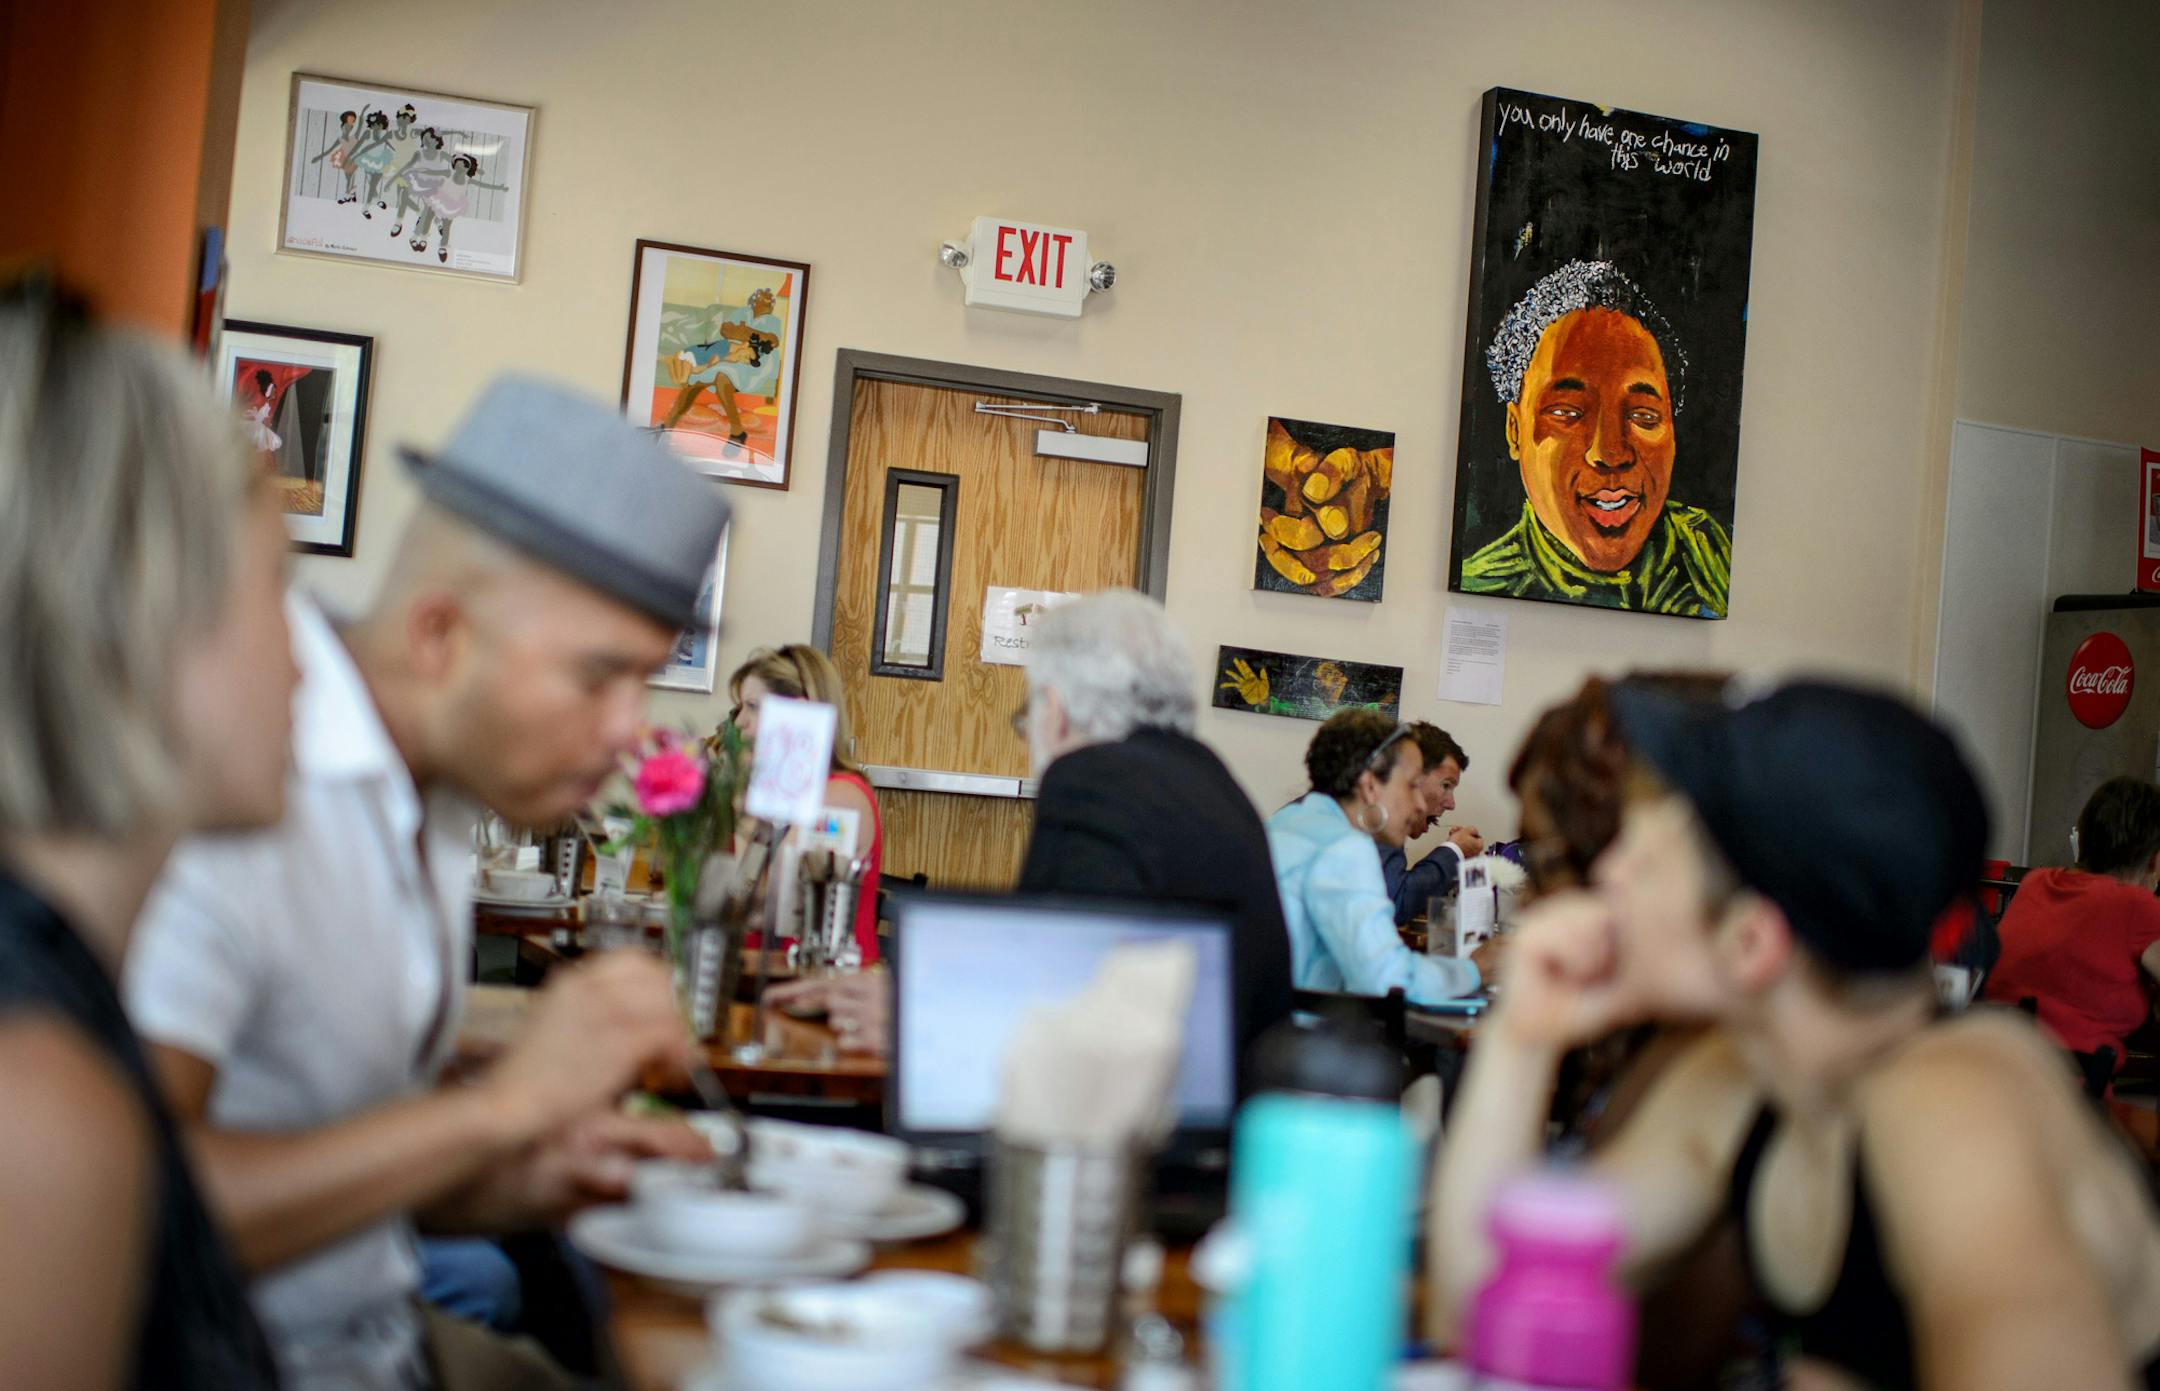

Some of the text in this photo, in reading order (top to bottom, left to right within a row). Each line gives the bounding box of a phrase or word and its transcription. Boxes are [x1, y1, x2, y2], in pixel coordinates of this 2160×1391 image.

[1499, 102, 1730, 161] you only have one chance in
[1611, 142, 1712, 182] this world
[994, 225, 1073, 289] EXIT
[2069, 665, 2133, 695] Coca-Cola
